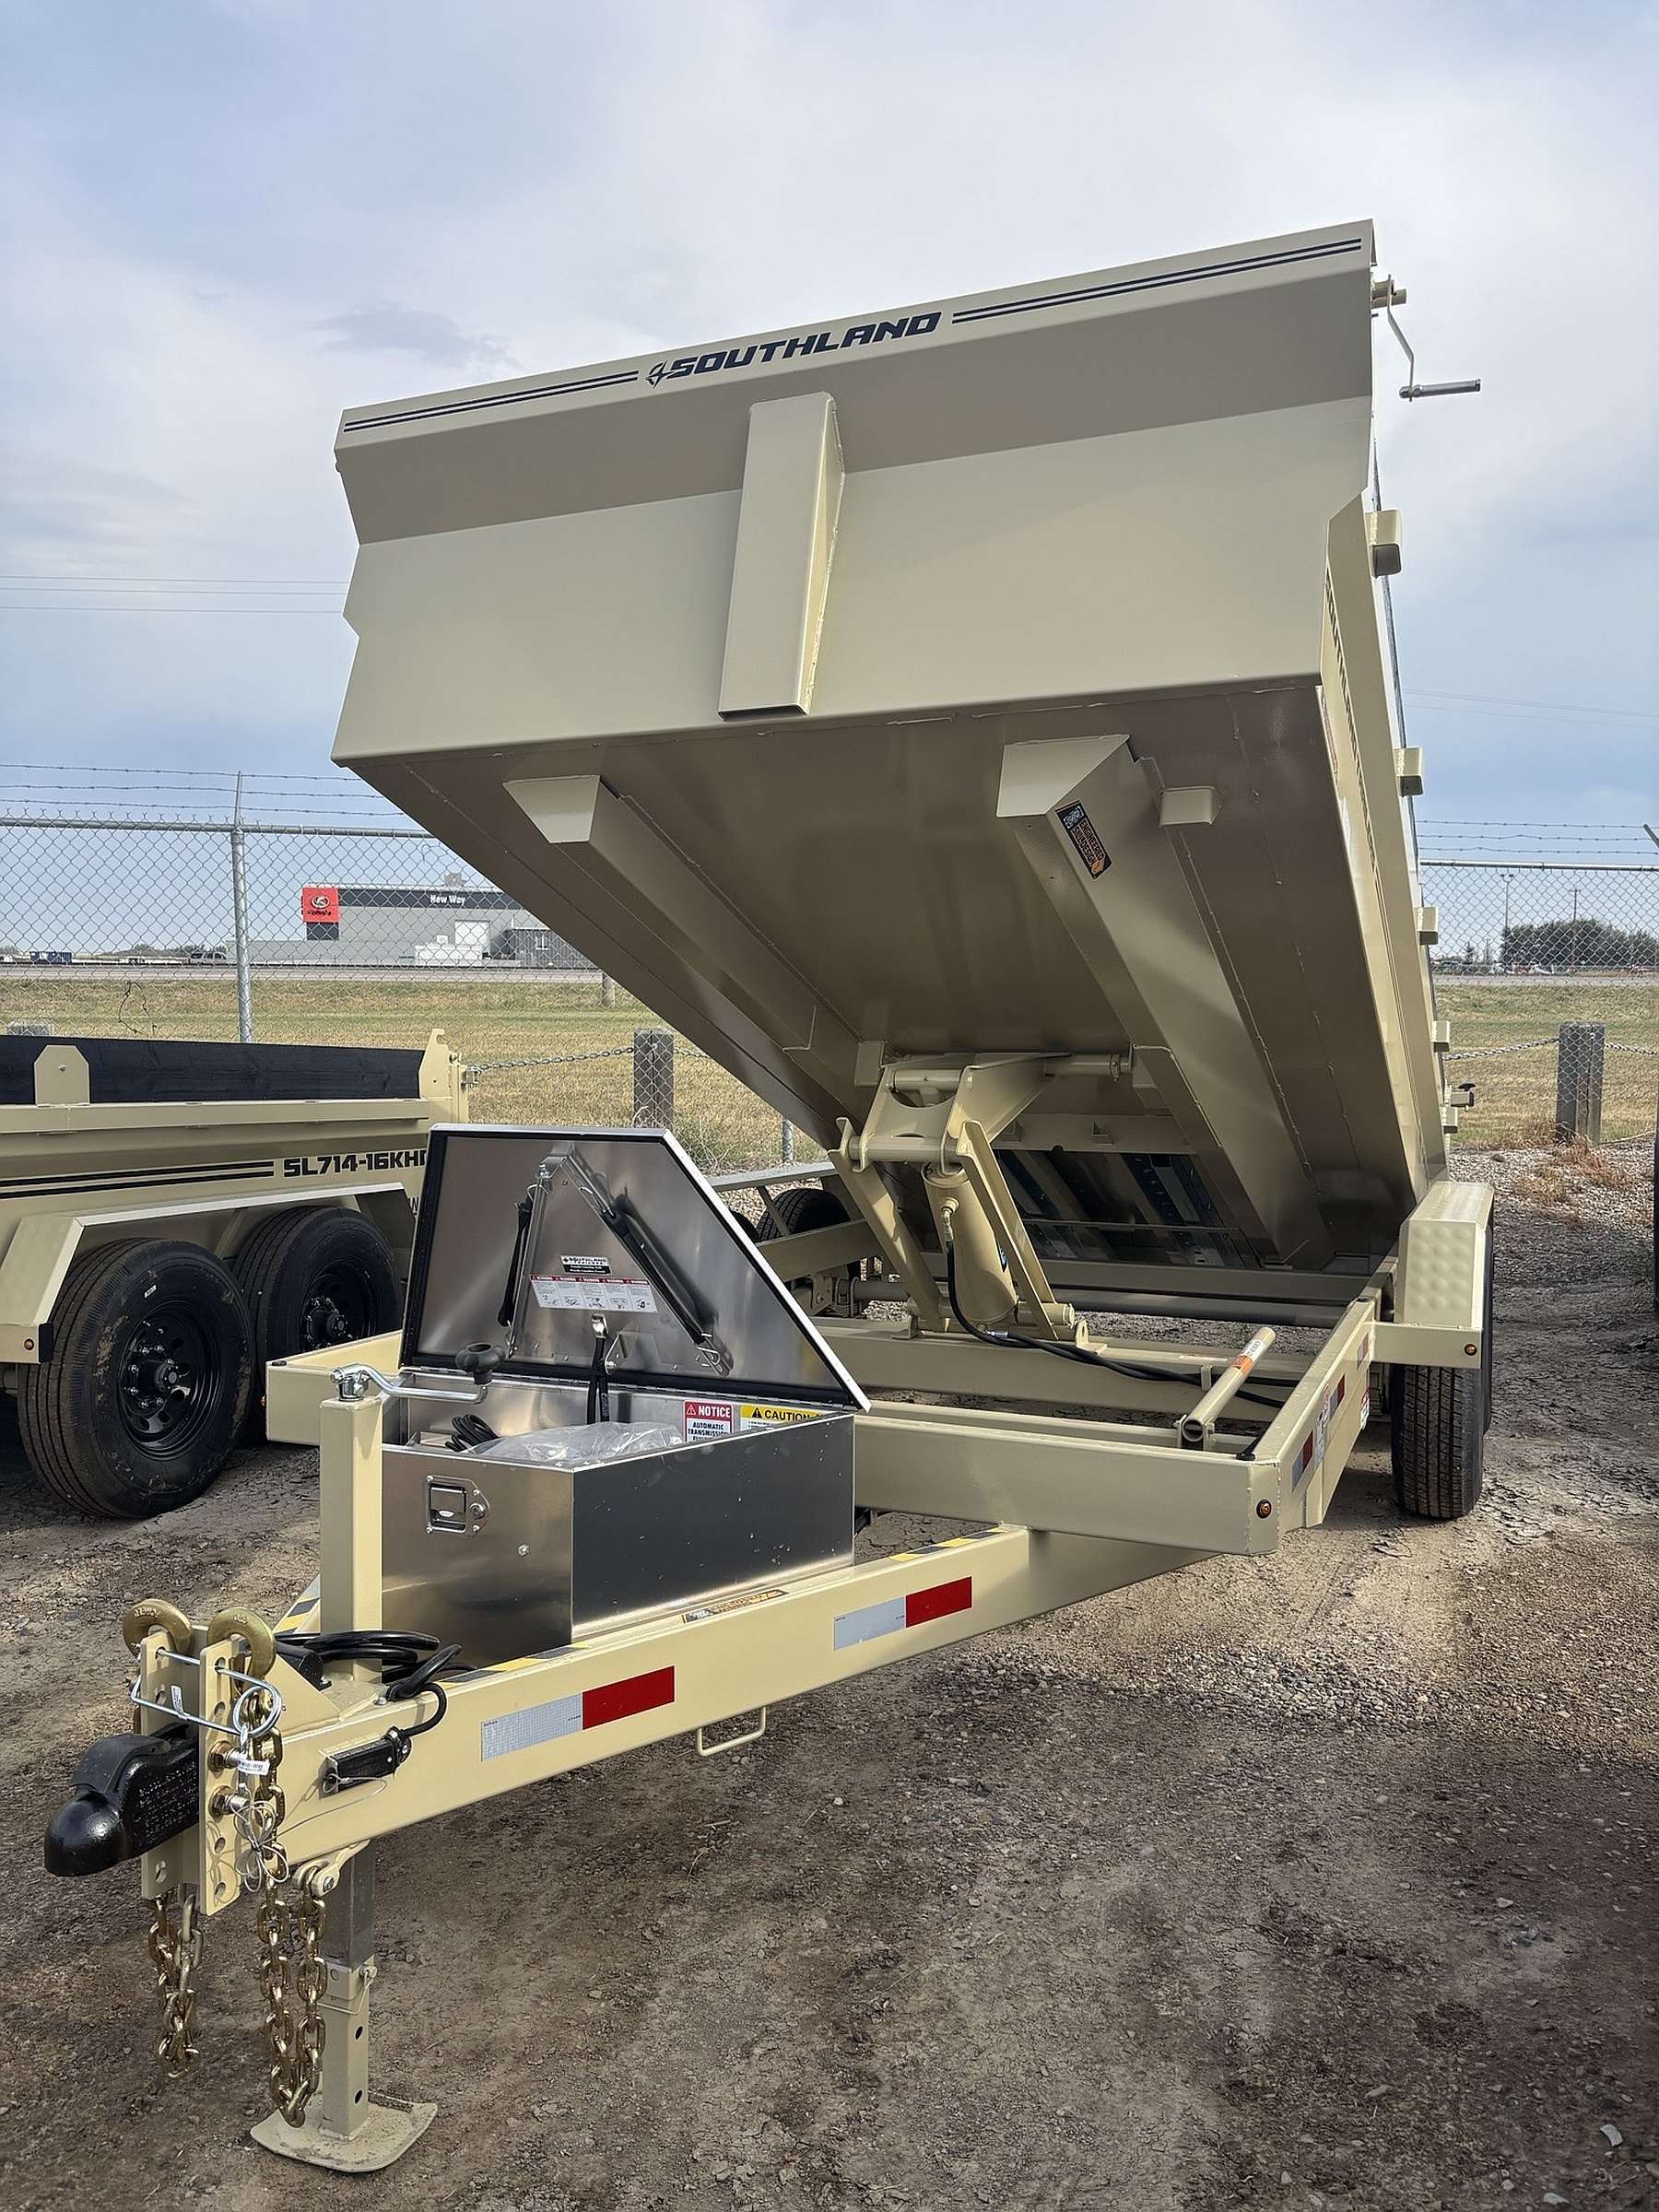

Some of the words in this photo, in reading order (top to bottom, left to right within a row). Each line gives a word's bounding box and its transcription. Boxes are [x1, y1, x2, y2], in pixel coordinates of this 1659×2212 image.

[666, 312, 942, 379] SOUTHLAND
[1079, 819, 1106, 862] ENGINEERED
[692, 1421, 724, 1430] AUTOMATIC
[698, 1406, 731, 1418] NOTICE
